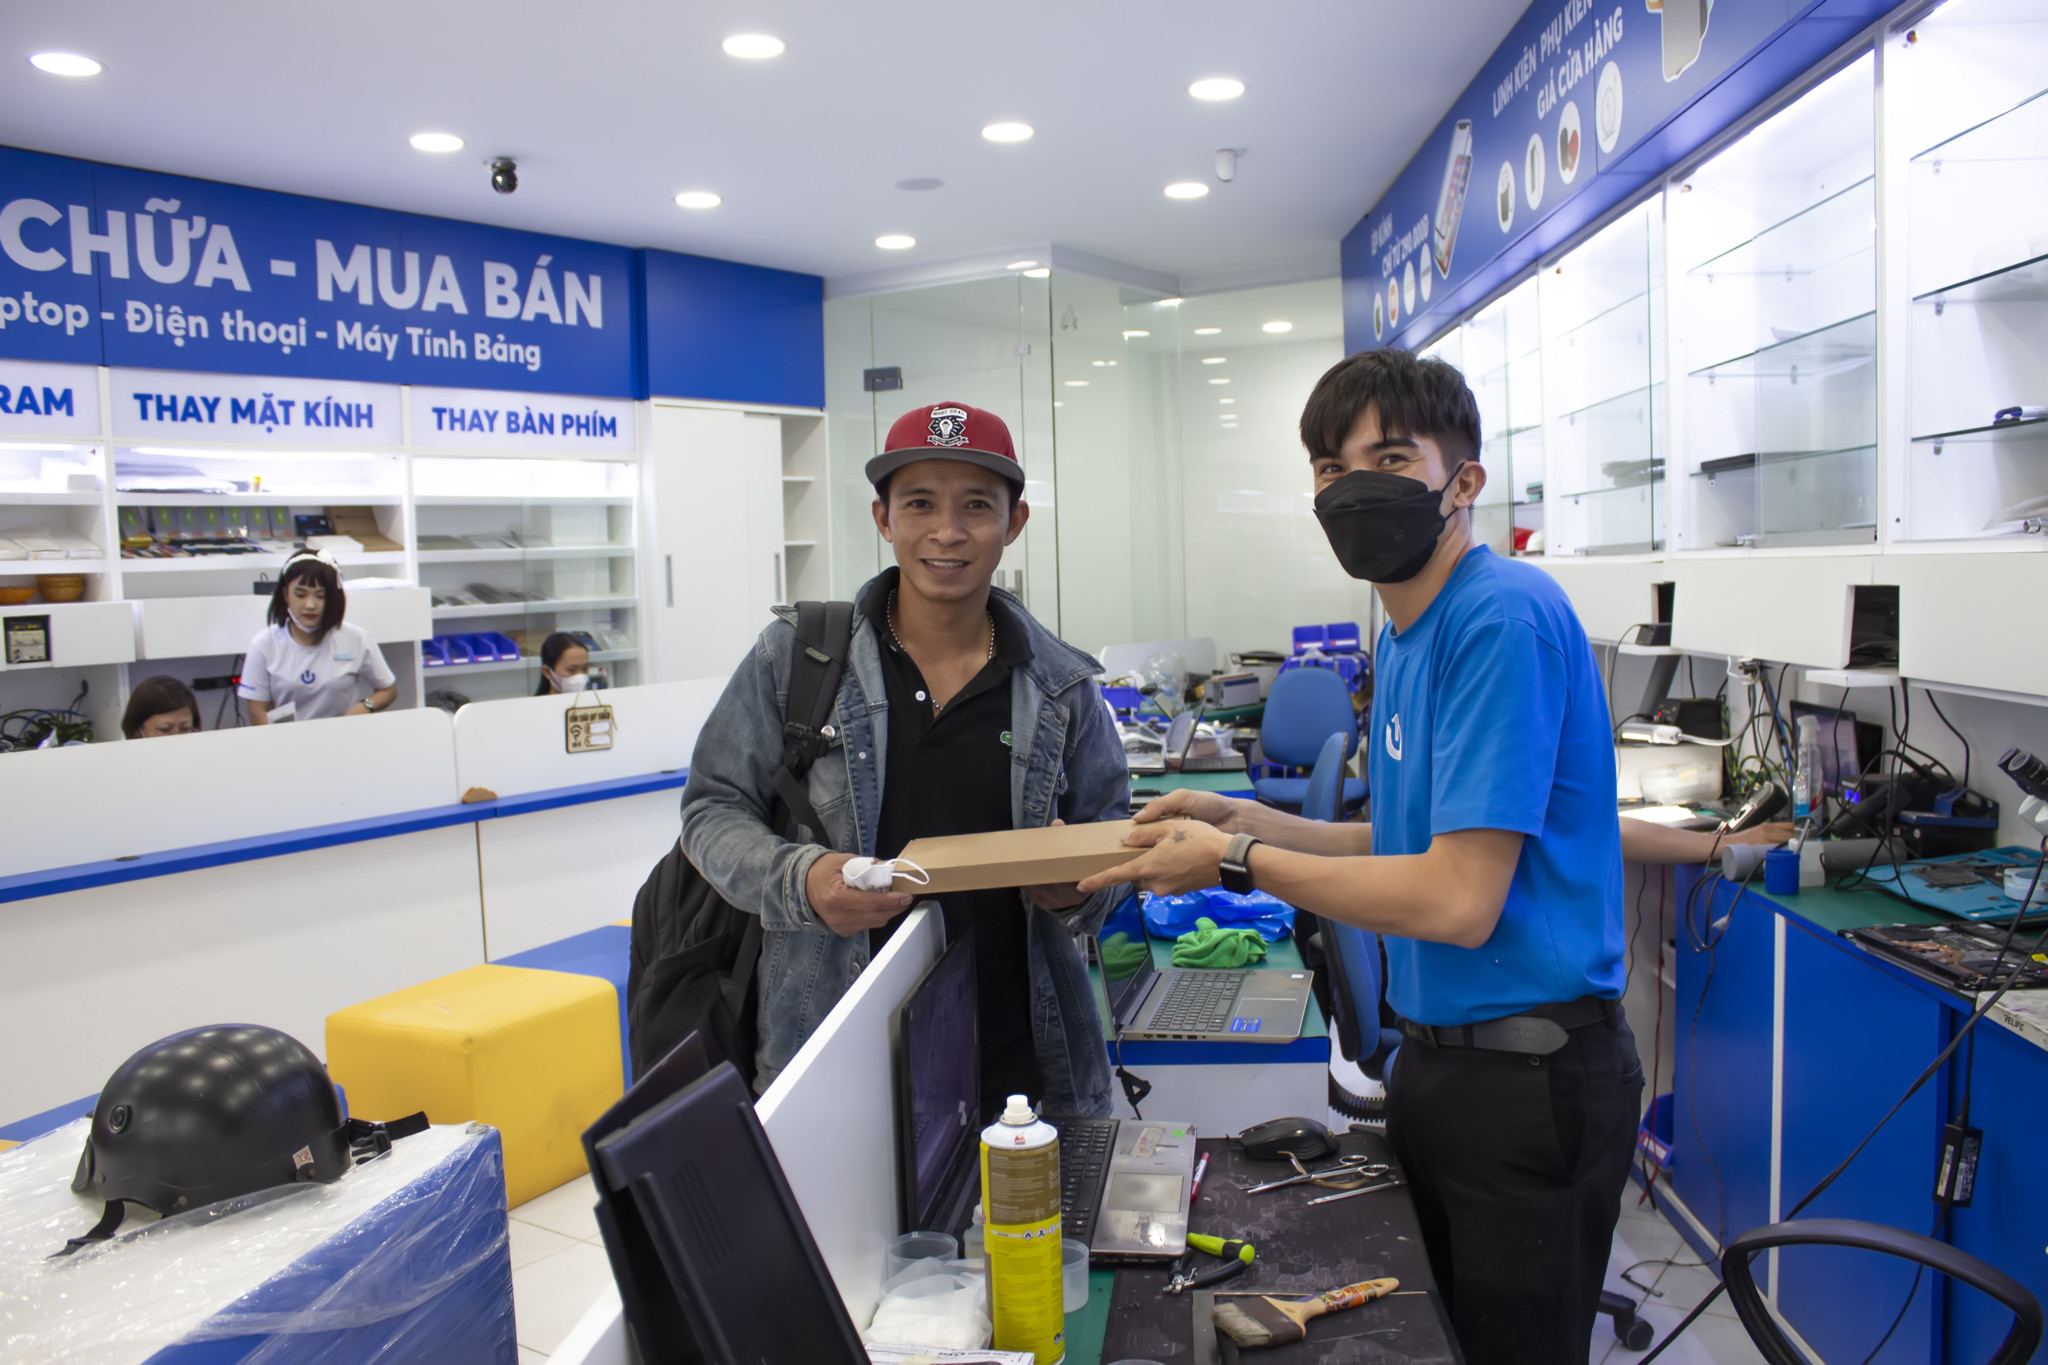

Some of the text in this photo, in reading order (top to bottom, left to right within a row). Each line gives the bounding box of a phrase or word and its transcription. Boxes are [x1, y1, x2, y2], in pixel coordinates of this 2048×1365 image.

[1493, 71, 1513, 118] LINH
[1540, 12, 1562, 63] PHỤ
[1537, 67, 1557, 120] GIÁ
[0, 197, 603, 329] CHỮA - MUA BÁN
[0, 291, 89, 336] ptop
[125, 300, 209, 347] Điện
[221, 309, 307, 355] thoại
[336, 320, 398, 361] Máy
[405, 326, 466, 359] Tính
[474, 333, 541, 371] Bảng
[0, 385, 74, 416] RAM
[133, 393, 373, 433] THAY MẶT KÍNH
[432, 406, 617, 437] THAY BÀN PHÍM
